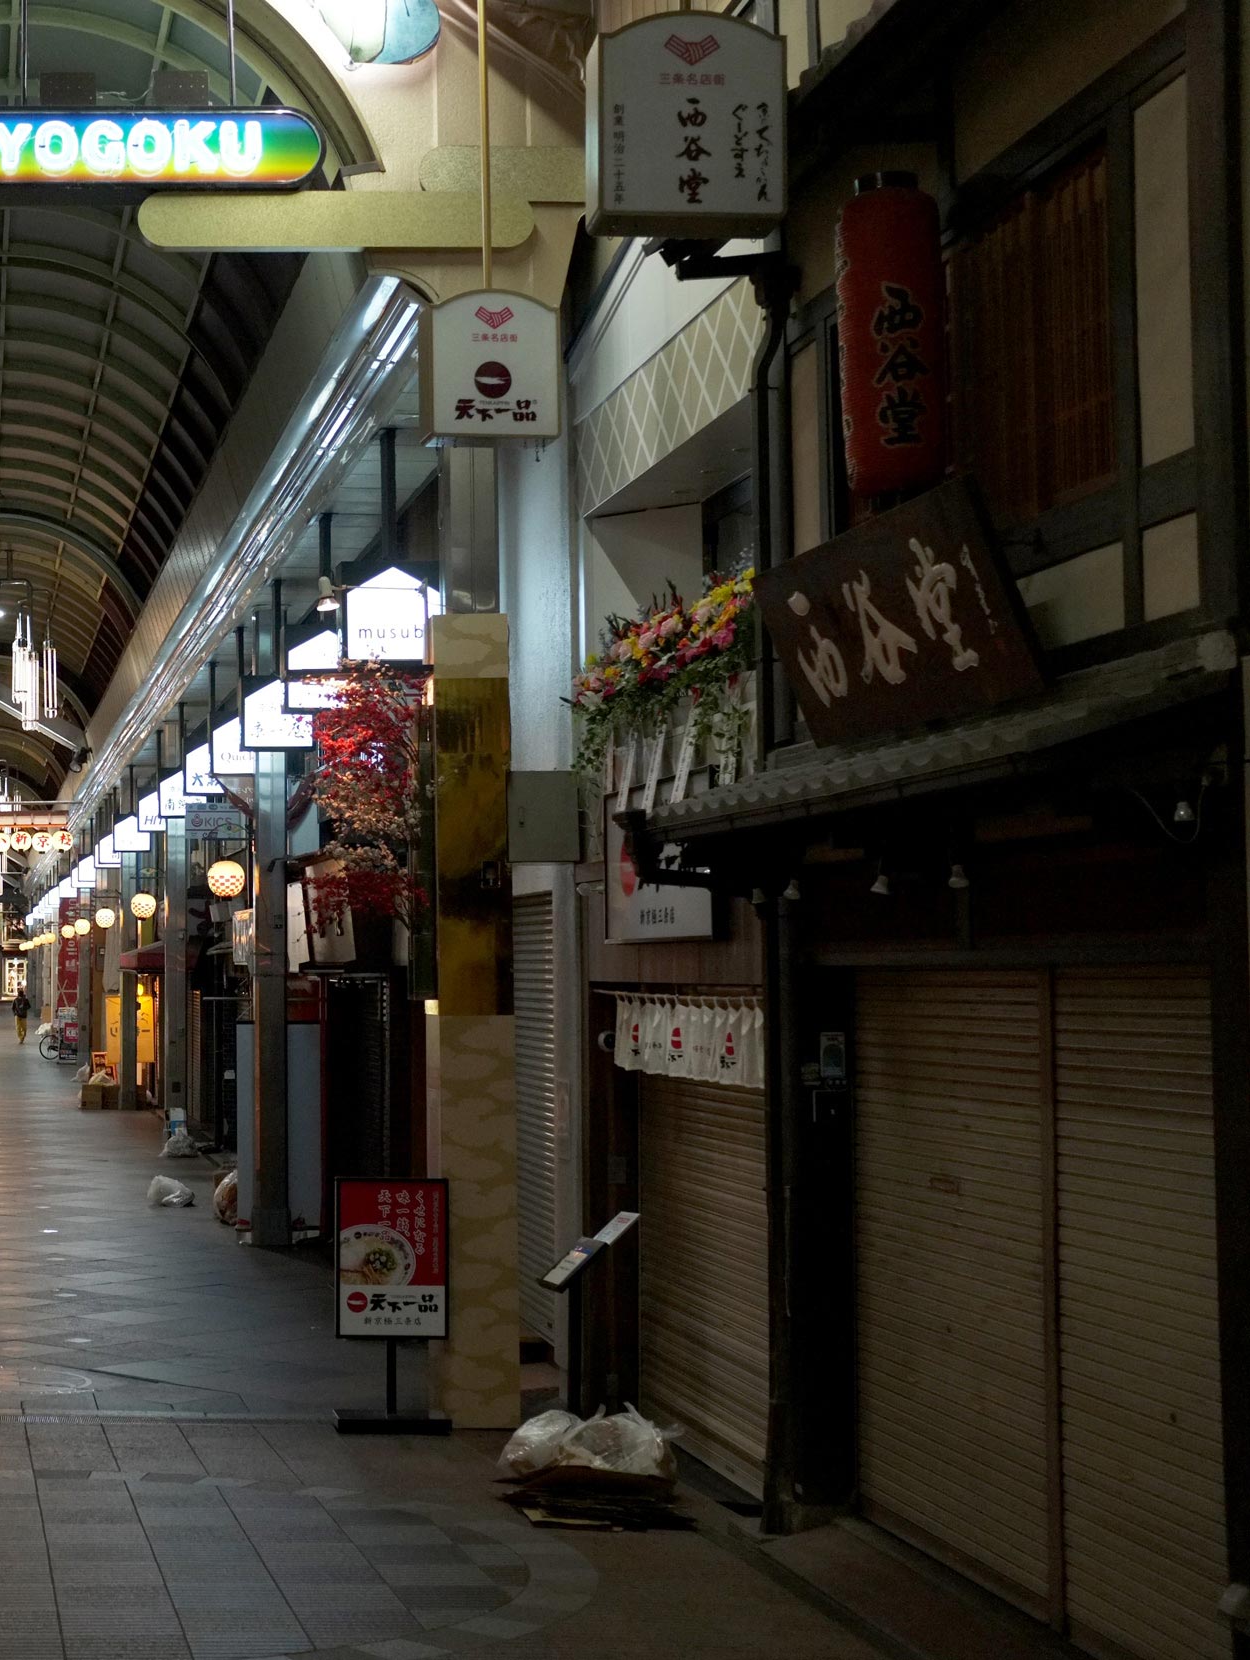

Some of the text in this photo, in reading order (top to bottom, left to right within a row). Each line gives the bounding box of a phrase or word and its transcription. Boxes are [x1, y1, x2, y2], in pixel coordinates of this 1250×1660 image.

[660, 73, 725, 86] 三条名店街
[676, 97, 712, 204] 西谷堂
[872, 283, 931, 447] 西谷堂
[454, 399, 537, 422] 天下一品
[787, 537, 980, 708] 西谷堂
[370, 1294, 439, 1313] 天下一品
